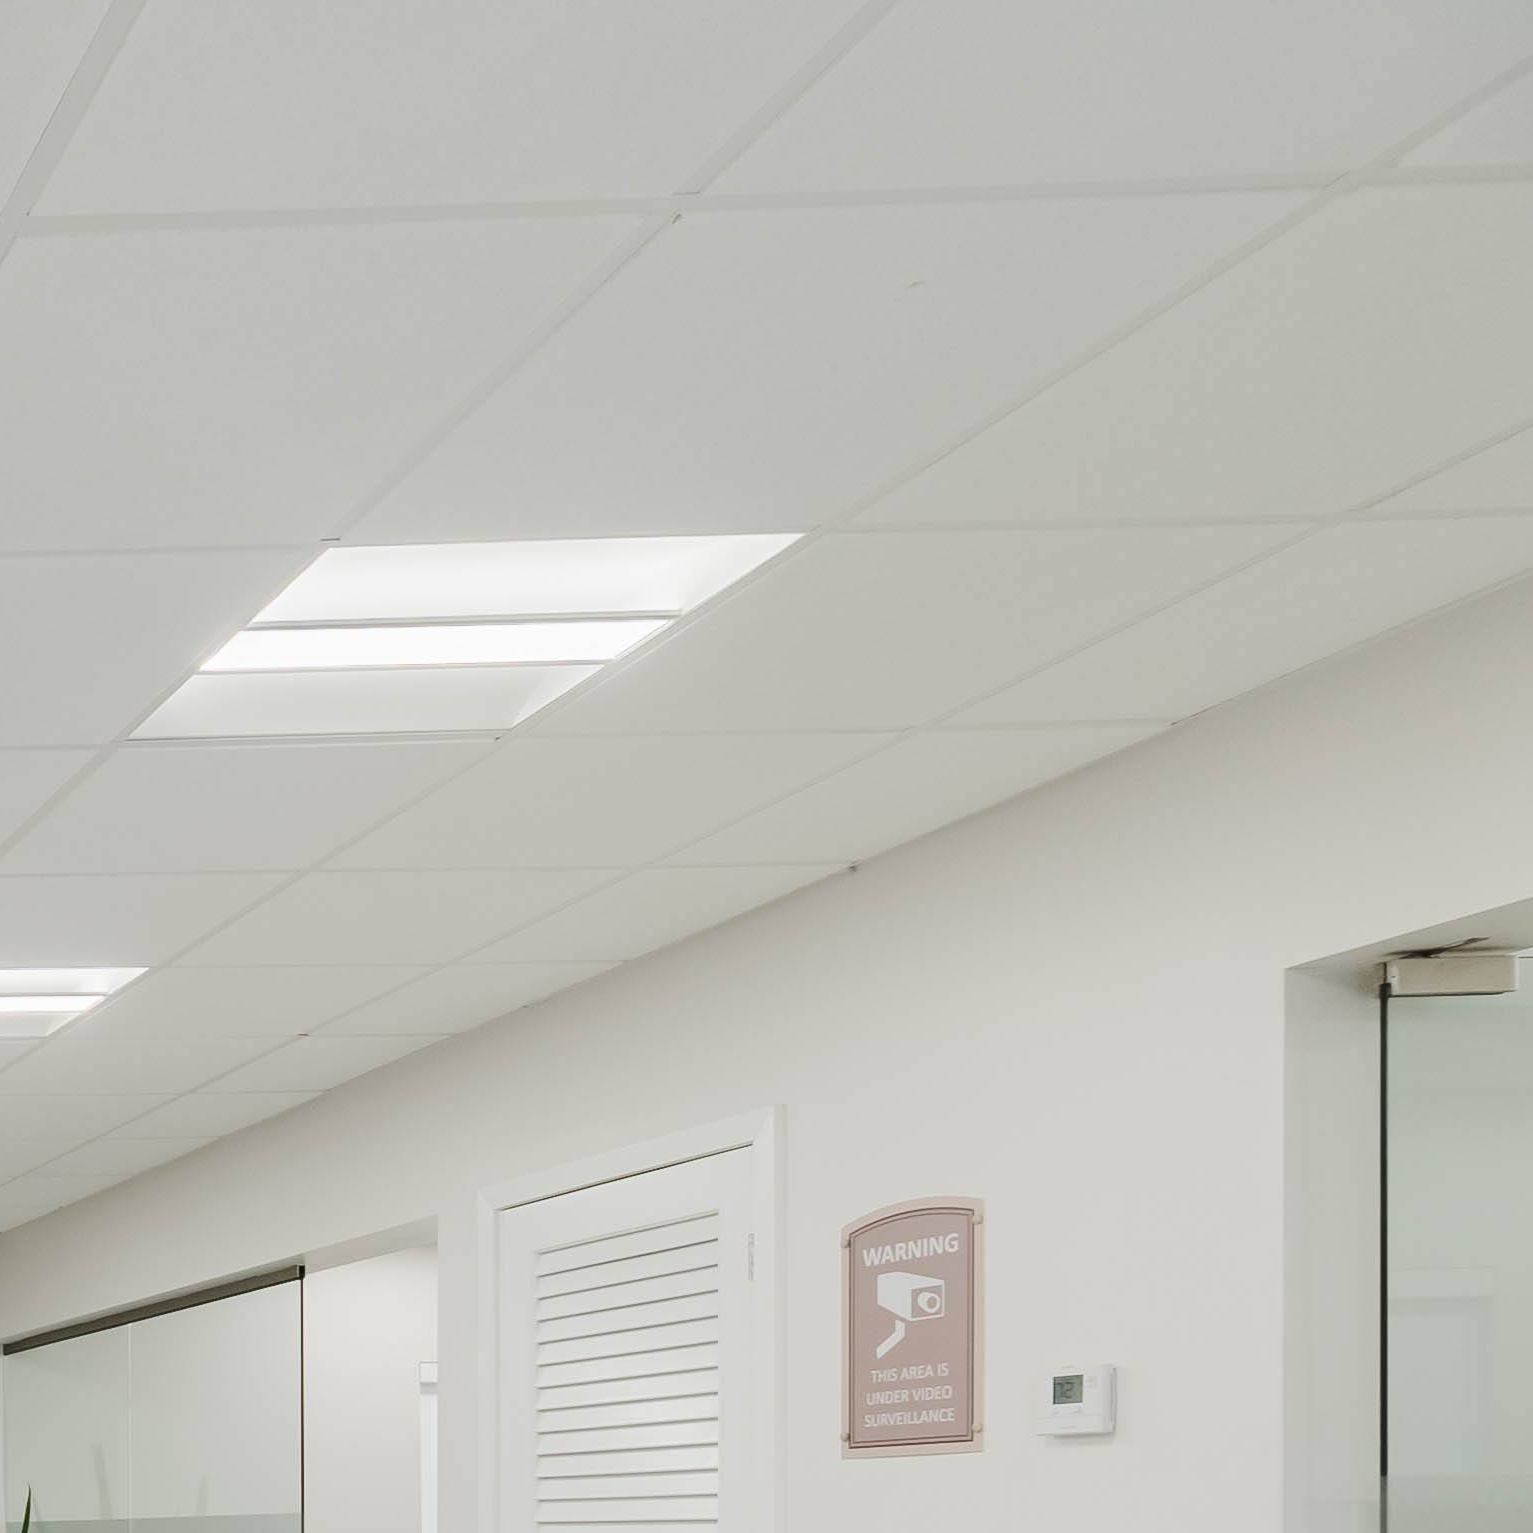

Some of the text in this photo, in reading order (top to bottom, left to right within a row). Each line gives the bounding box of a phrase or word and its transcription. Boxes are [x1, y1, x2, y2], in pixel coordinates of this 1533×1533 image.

[862, 1232, 960, 1268] WARNING
[870, 1362, 950, 1383] THIS AREA IS
[866, 1385, 953, 1406] UNDER VIDEO
[863, 1407, 956, 1428] SURVEILLANCE
